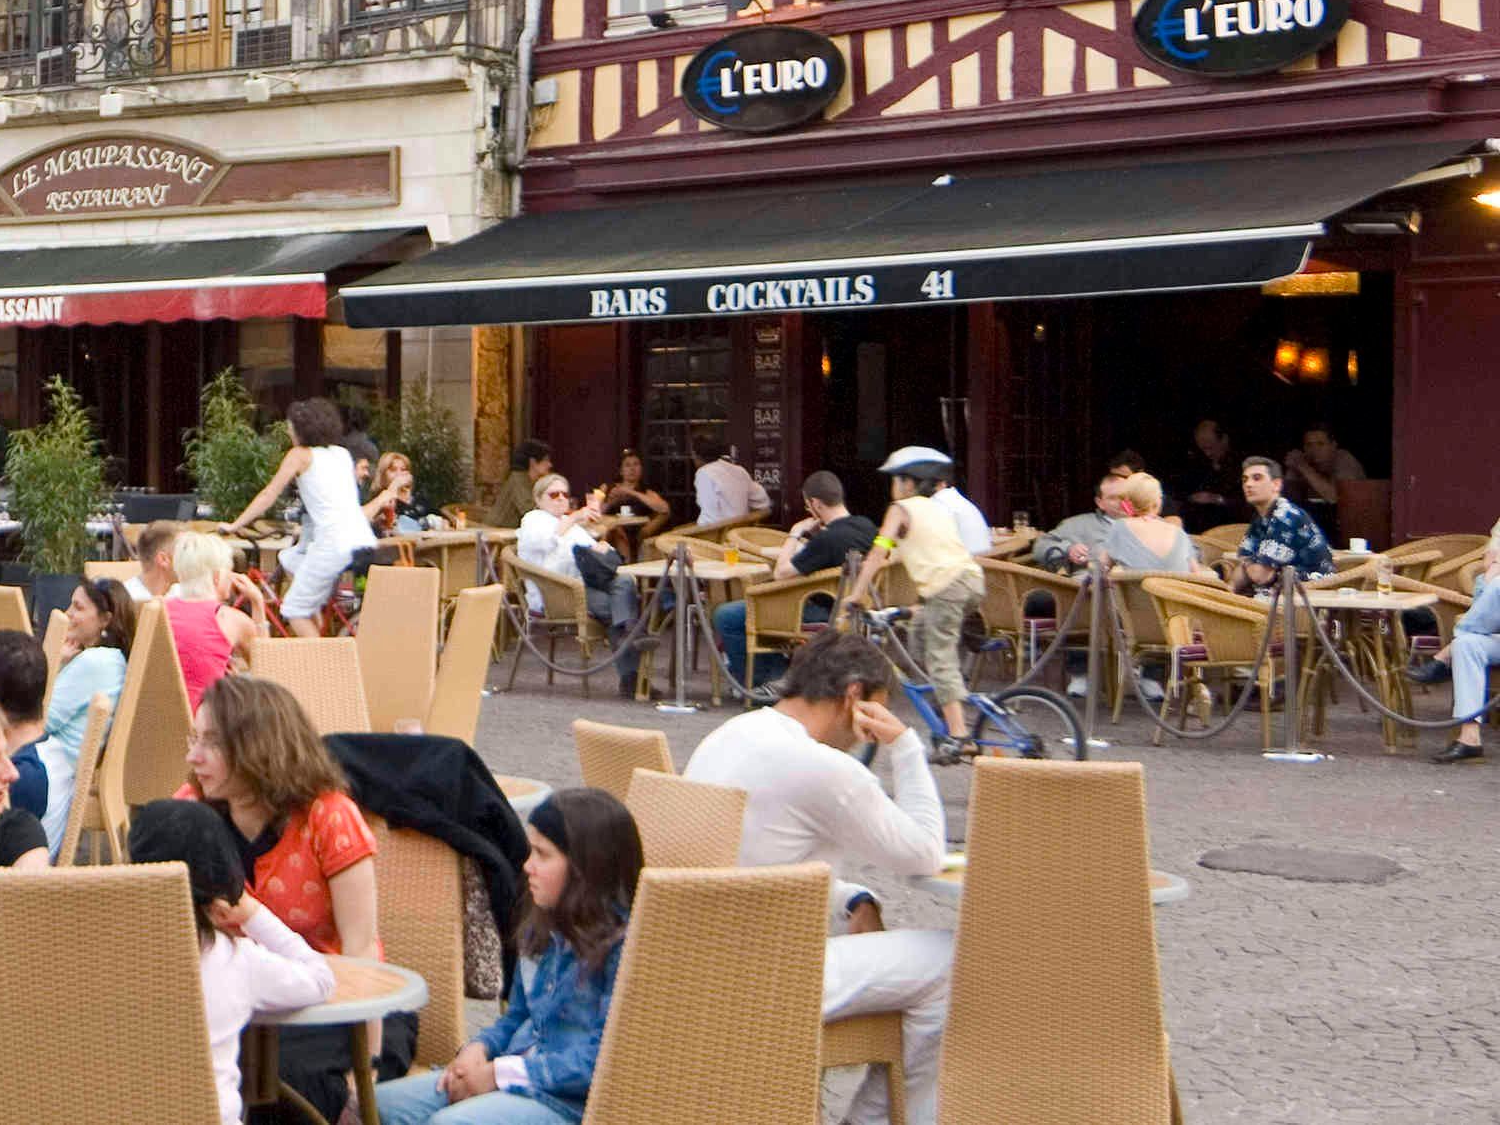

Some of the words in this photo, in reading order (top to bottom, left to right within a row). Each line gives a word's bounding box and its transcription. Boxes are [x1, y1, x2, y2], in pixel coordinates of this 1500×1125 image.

[720, 56, 828, 99] L'EURO
[12, 164, 41, 198] LE
[44, 145, 214, 185] MAUPASSANT
[46, 183, 170, 212] RESTAURANT
[589, 286, 668, 317] BARS
[706, 274, 875, 313] COCKTAILS
[920, 269, 955, 299] 41
[754, 408, 781, 425] BAR
[754, 468, 781, 484] BAR
